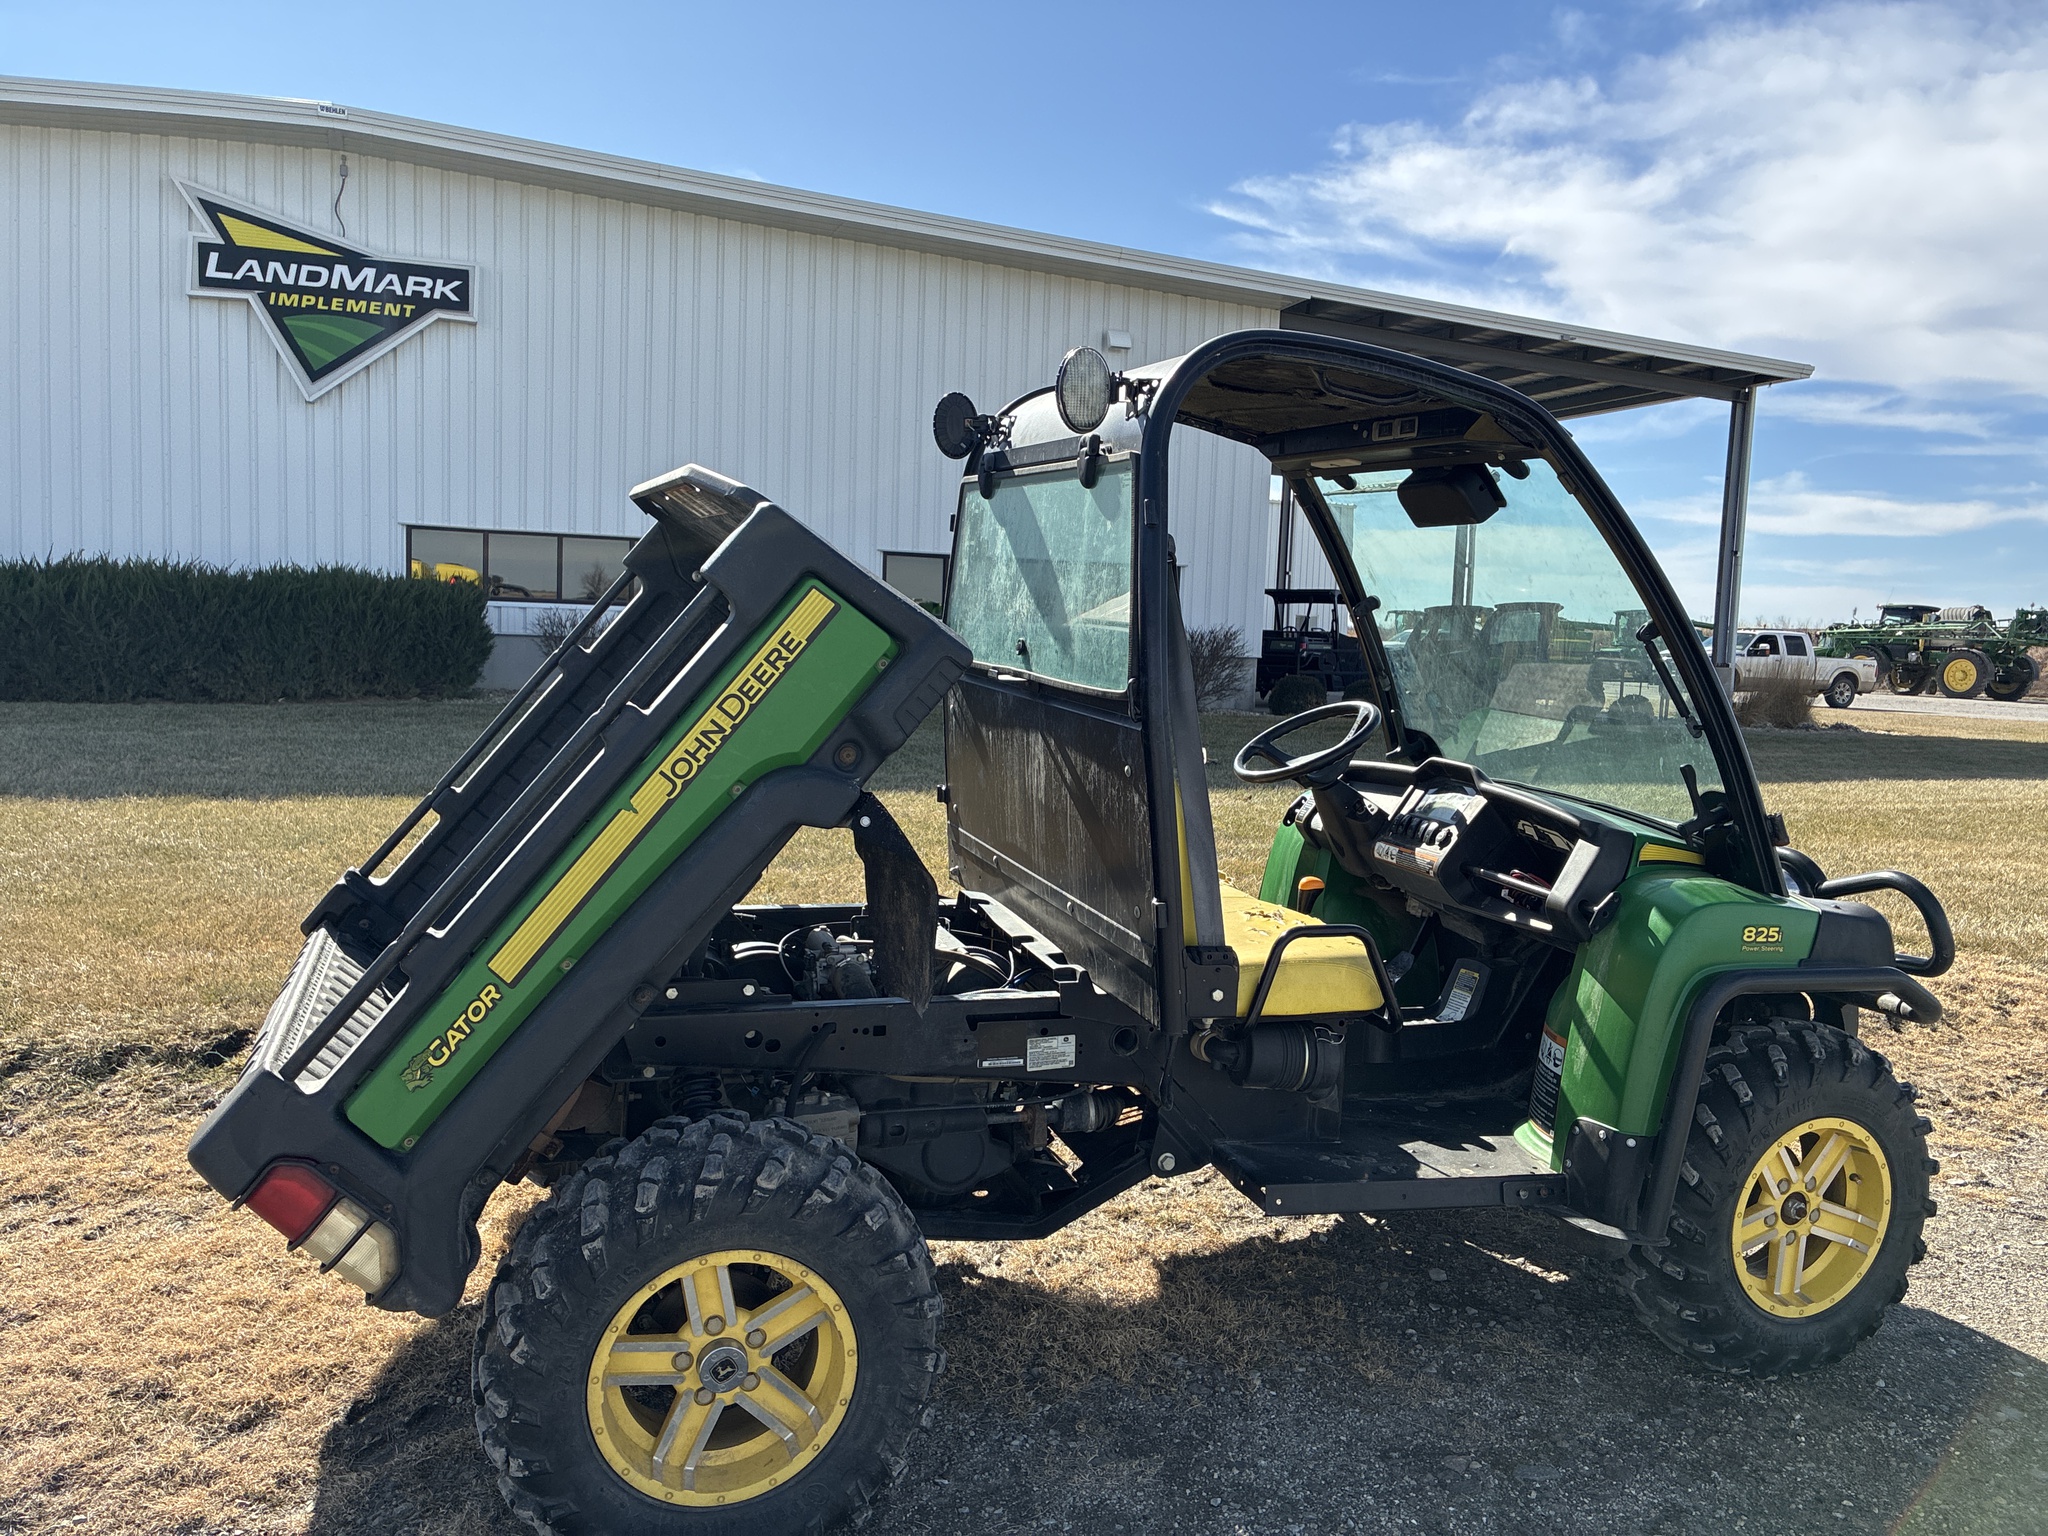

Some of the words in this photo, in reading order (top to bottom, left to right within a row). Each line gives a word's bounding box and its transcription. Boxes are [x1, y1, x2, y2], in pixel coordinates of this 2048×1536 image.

[325, 106, 346, 115] BEHLEN
[205, 252, 464, 302] LANDMARK
[269, 292, 416, 318] IMPLEMENT
[659, 719, 726, 798] JOHN
[717, 630, 803, 722] DEERE
[1742, 926, 1782, 942] 825i
[1761, 945, 1784, 953] Steering
[428, 984, 502, 1067] GATOR
